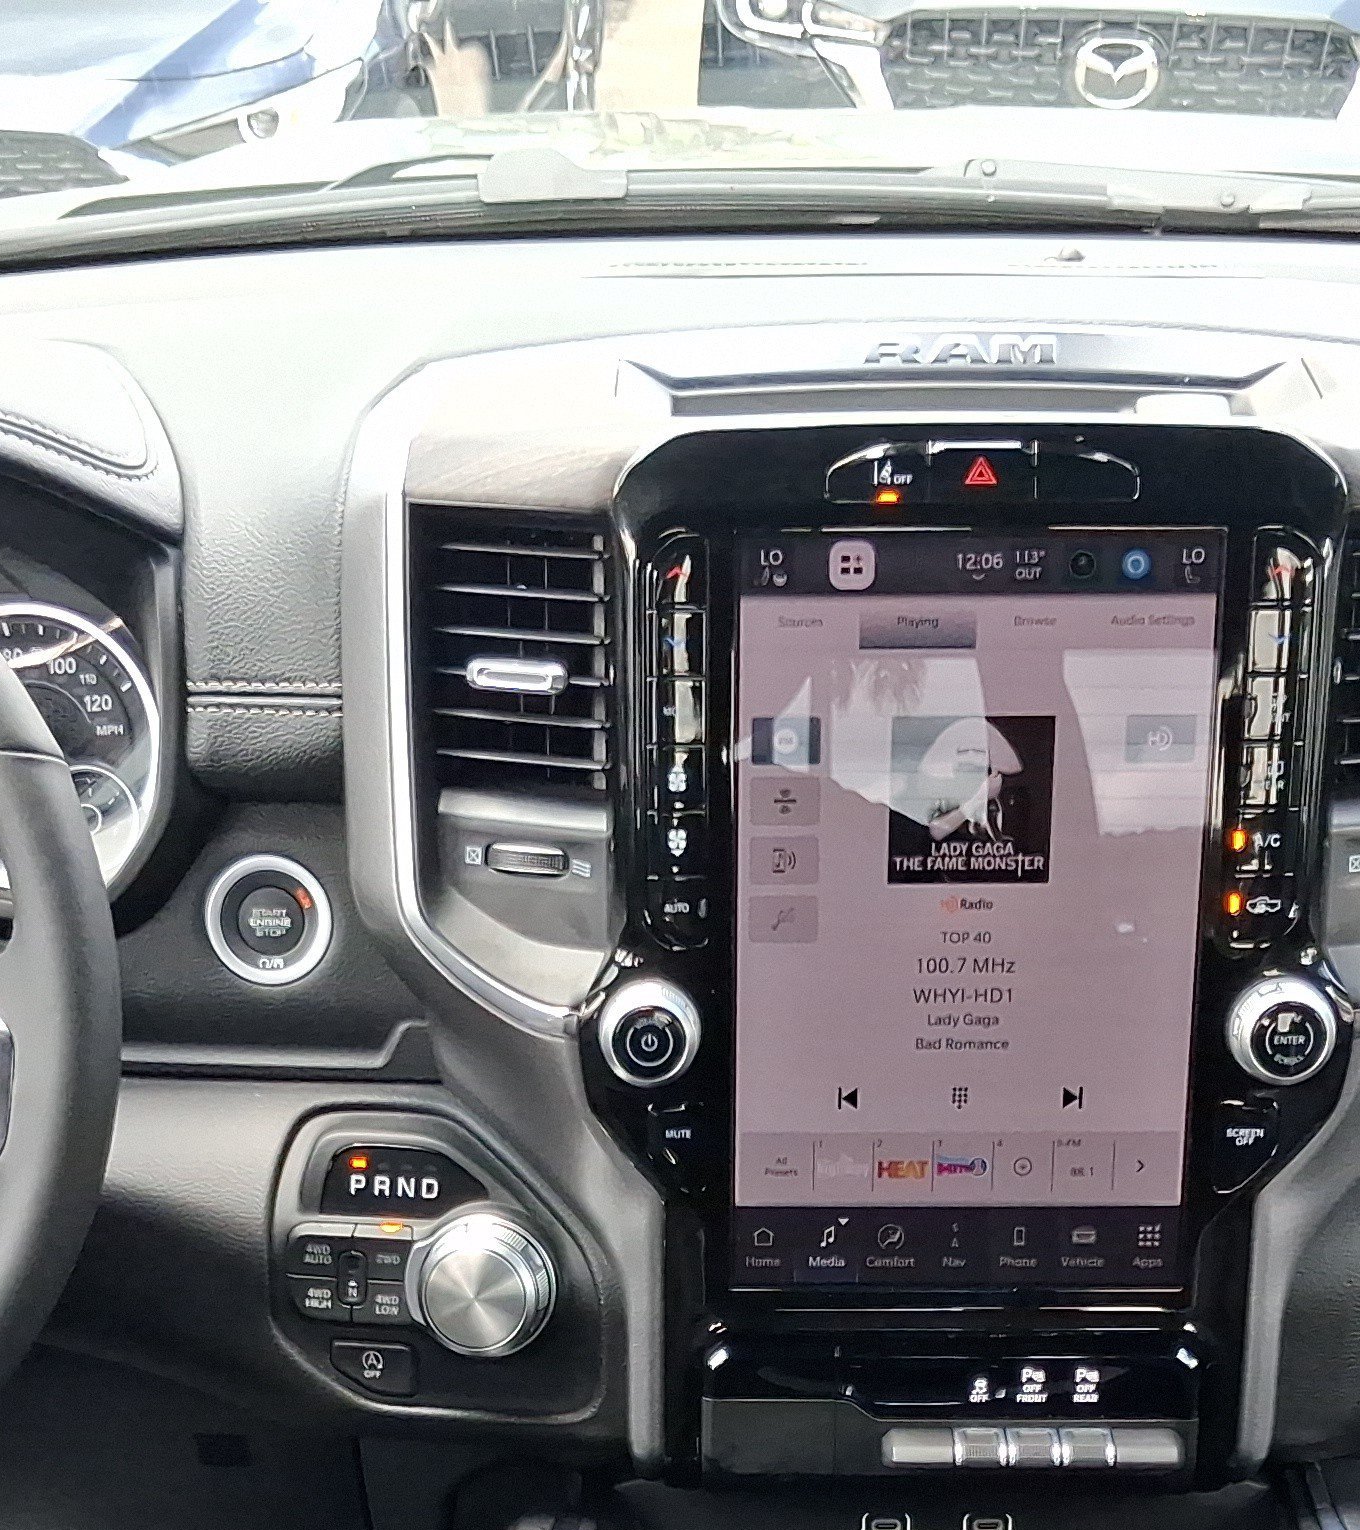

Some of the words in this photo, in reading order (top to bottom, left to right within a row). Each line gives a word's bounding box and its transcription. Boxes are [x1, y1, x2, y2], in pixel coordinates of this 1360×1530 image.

[863, 334, 1057, 364] RAM
[893, 474, 913, 485] OFF
[759, 549, 783, 566] LO
[956, 553, 1004, 571] 12:06
[1182, 548, 1205, 564] LO
[1015, 566, 1043, 580] OUT
[897, 615, 939, 629] Playing
[1013, 615, 1058, 627] Browse
[1110, 614, 1145, 627] Audio
[1148, 615, 1196, 629] Settings
[46, 658, 77, 675] 100
[83, 694, 113, 712] 120
[96, 724, 124, 736] MPH
[931, 842, 969, 857] LADY
[971, 842, 1014, 857] GAGA
[894, 856, 923, 871] THE
[926, 856, 967, 871] FAME
[970, 852, 1045, 878] MONSTER
[664, 902, 690, 914] AUTO
[959, 897, 994, 910] Radio
[941, 931, 970, 944] TOP
[972, 931, 992, 944] 40
[917, 957, 967, 974] 100.7
[972, 957, 1016, 974] MHz
[913, 987, 1013, 1004] WHYI-HD1
[927, 1013, 960, 1028] Lady
[962, 1013, 1000, 1028] Gaga
[915, 1037, 942, 1050] Bad
[944, 1037, 1010, 1050] Romance
[1273, 1035, 1306, 1046] ENTER
[665, 1129, 692, 1139] MUTE
[1226, 1128, 1264, 1138] SCREEN
[877, 1159, 930, 1179] HEAT
[306, 1244, 330, 1254] 4WD
[304, 1254, 332, 1265] AUTO
[745, 1256, 781, 1268] Home
[808, 1256, 846, 1268] Media
[866, 1256, 915, 1268] Comfort
[943, 1256, 966, 1268] Nav
[999, 1256, 1037, 1268] Phone
[1061, 1256, 1105, 1268] Vehicle
[1132, 1256, 1164, 1270] Apps
[307, 1287, 332, 1298] 4WD
[305, 1298, 332, 1309] HIGH
[375, 1294, 399, 1305] 4WD
[375, 1304, 399, 1316] LOW
[1022, 1384, 1042, 1393] OFF
[1075, 1384, 1097, 1393] OFF
[969, 1394, 989, 1403] OFF
[1017, 1393, 1048, 1403] FRONT
[1072, 1393, 1099, 1403] REAR
